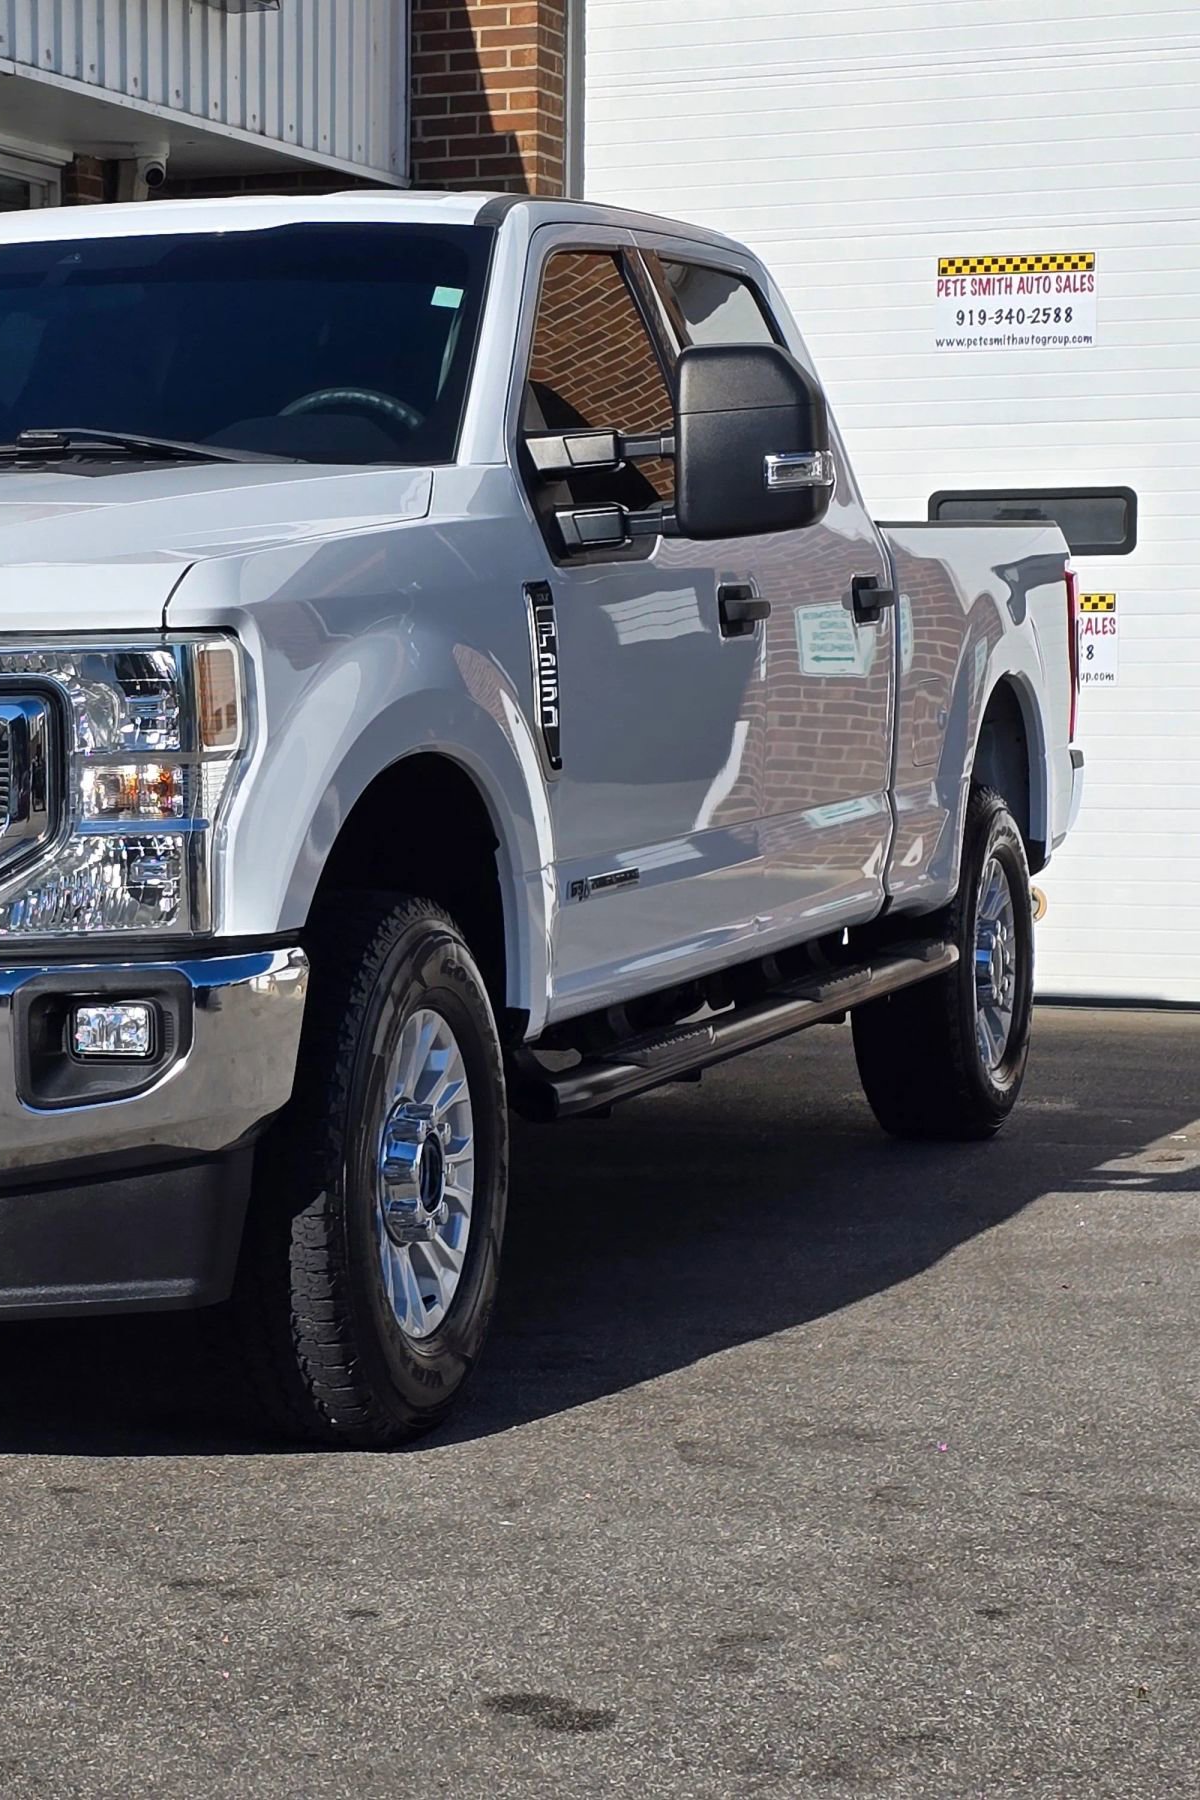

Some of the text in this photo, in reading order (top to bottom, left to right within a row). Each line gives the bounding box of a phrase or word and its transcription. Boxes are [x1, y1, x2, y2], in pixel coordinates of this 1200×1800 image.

[937, 274, 1094, 298] PETE SMITH AUTO SALES
[956, 307, 1073, 326] 919-340-2588
[936, 334, 1093, 349] www.petesmithautogroup.com
